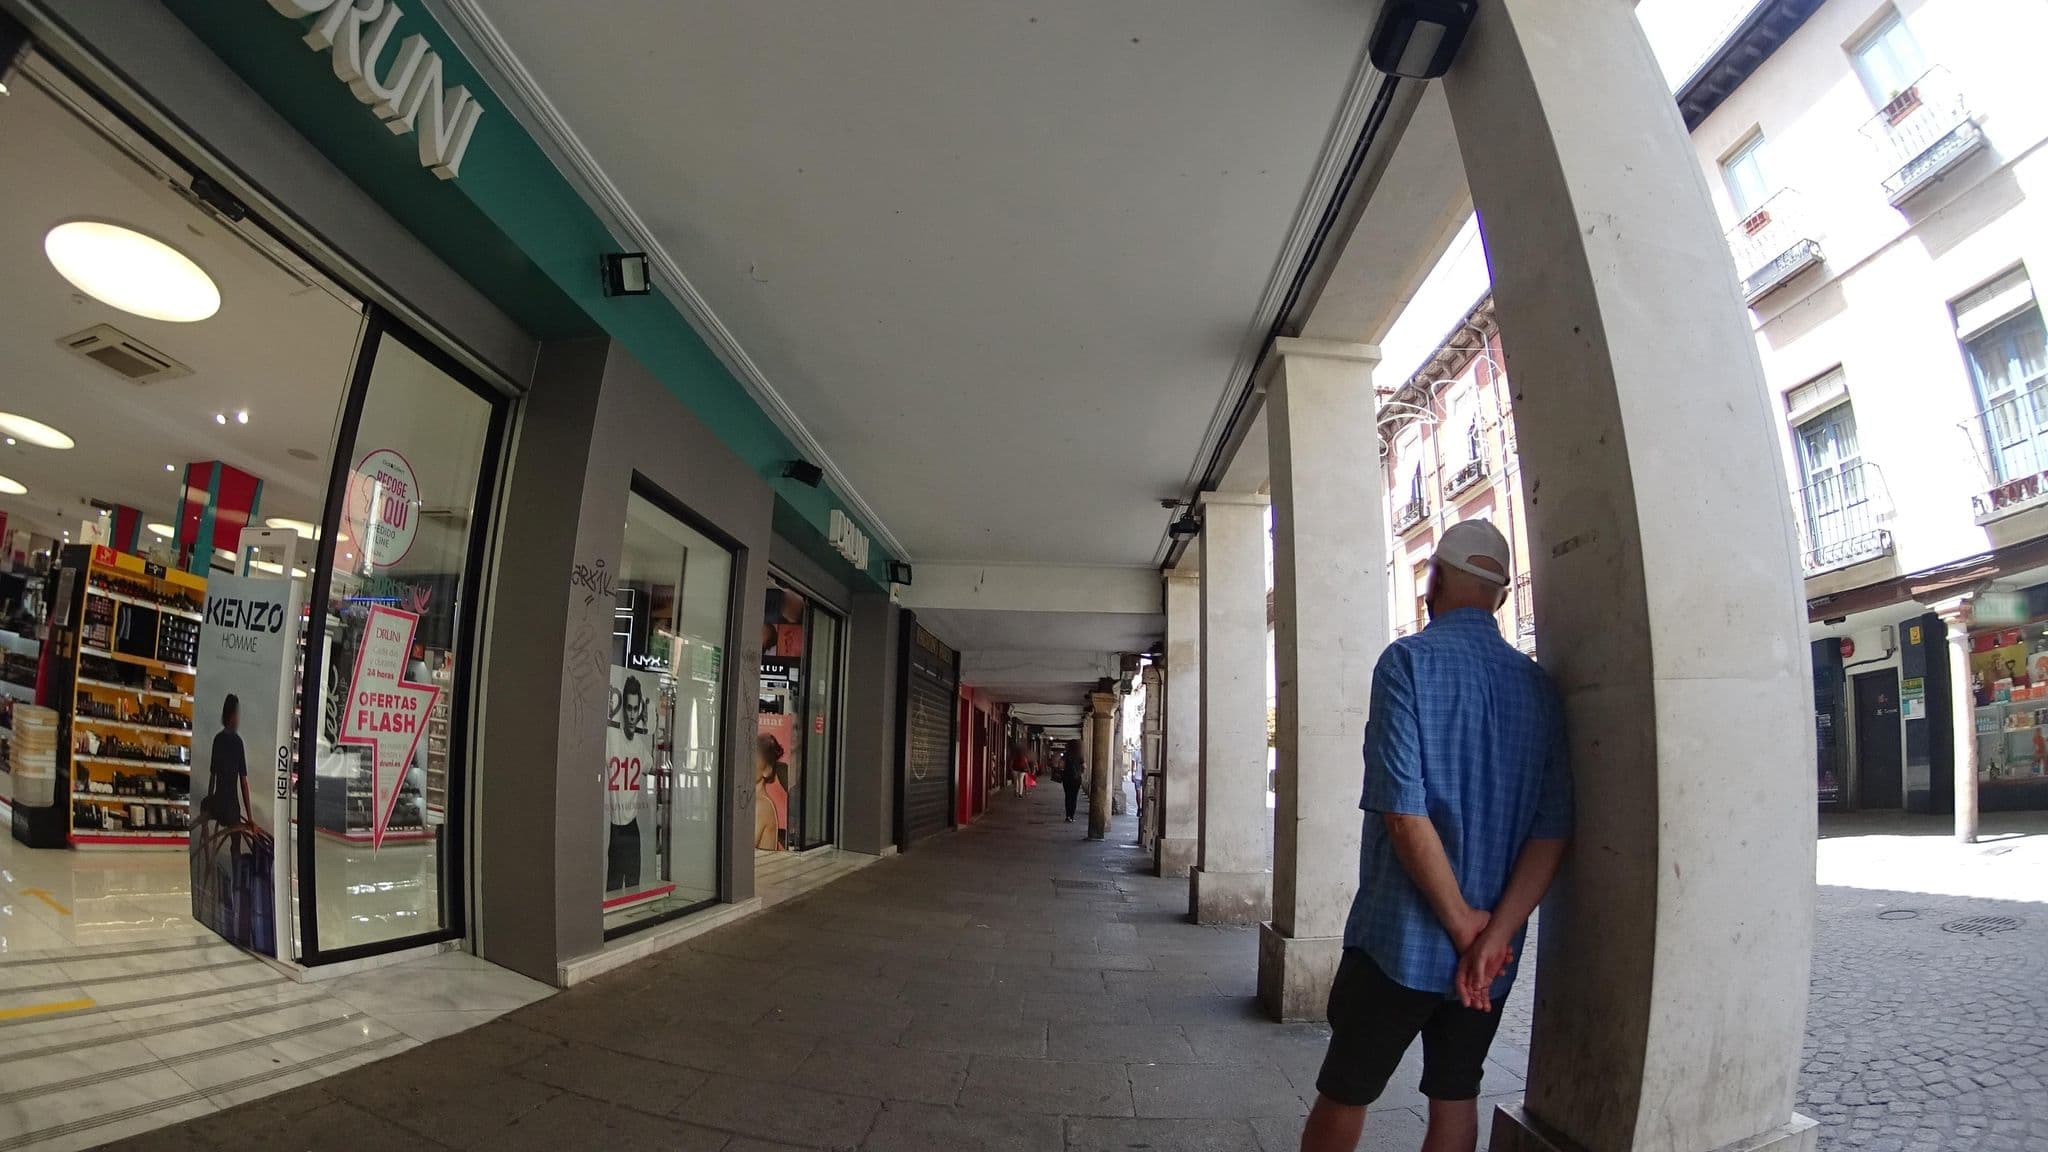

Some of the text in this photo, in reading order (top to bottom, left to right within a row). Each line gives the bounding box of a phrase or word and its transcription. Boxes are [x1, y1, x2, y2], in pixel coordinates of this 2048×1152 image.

[379, 495, 411, 531] QUÍ
[373, 524, 396, 540] EDIDO
[829, 509, 869, 570] DRUNI
[205, 596, 284, 633] KENZO
[221, 632, 258, 653] HOMME
[376, 627, 401, 643] DRUNI
[761, 664, 784, 672] KEUP
[359, 691, 417, 711] OFERTAS
[358, 710, 416, 733] FLASH
[277, 745, 289, 800] KENZO
[608, 756, 641, 791] 212
